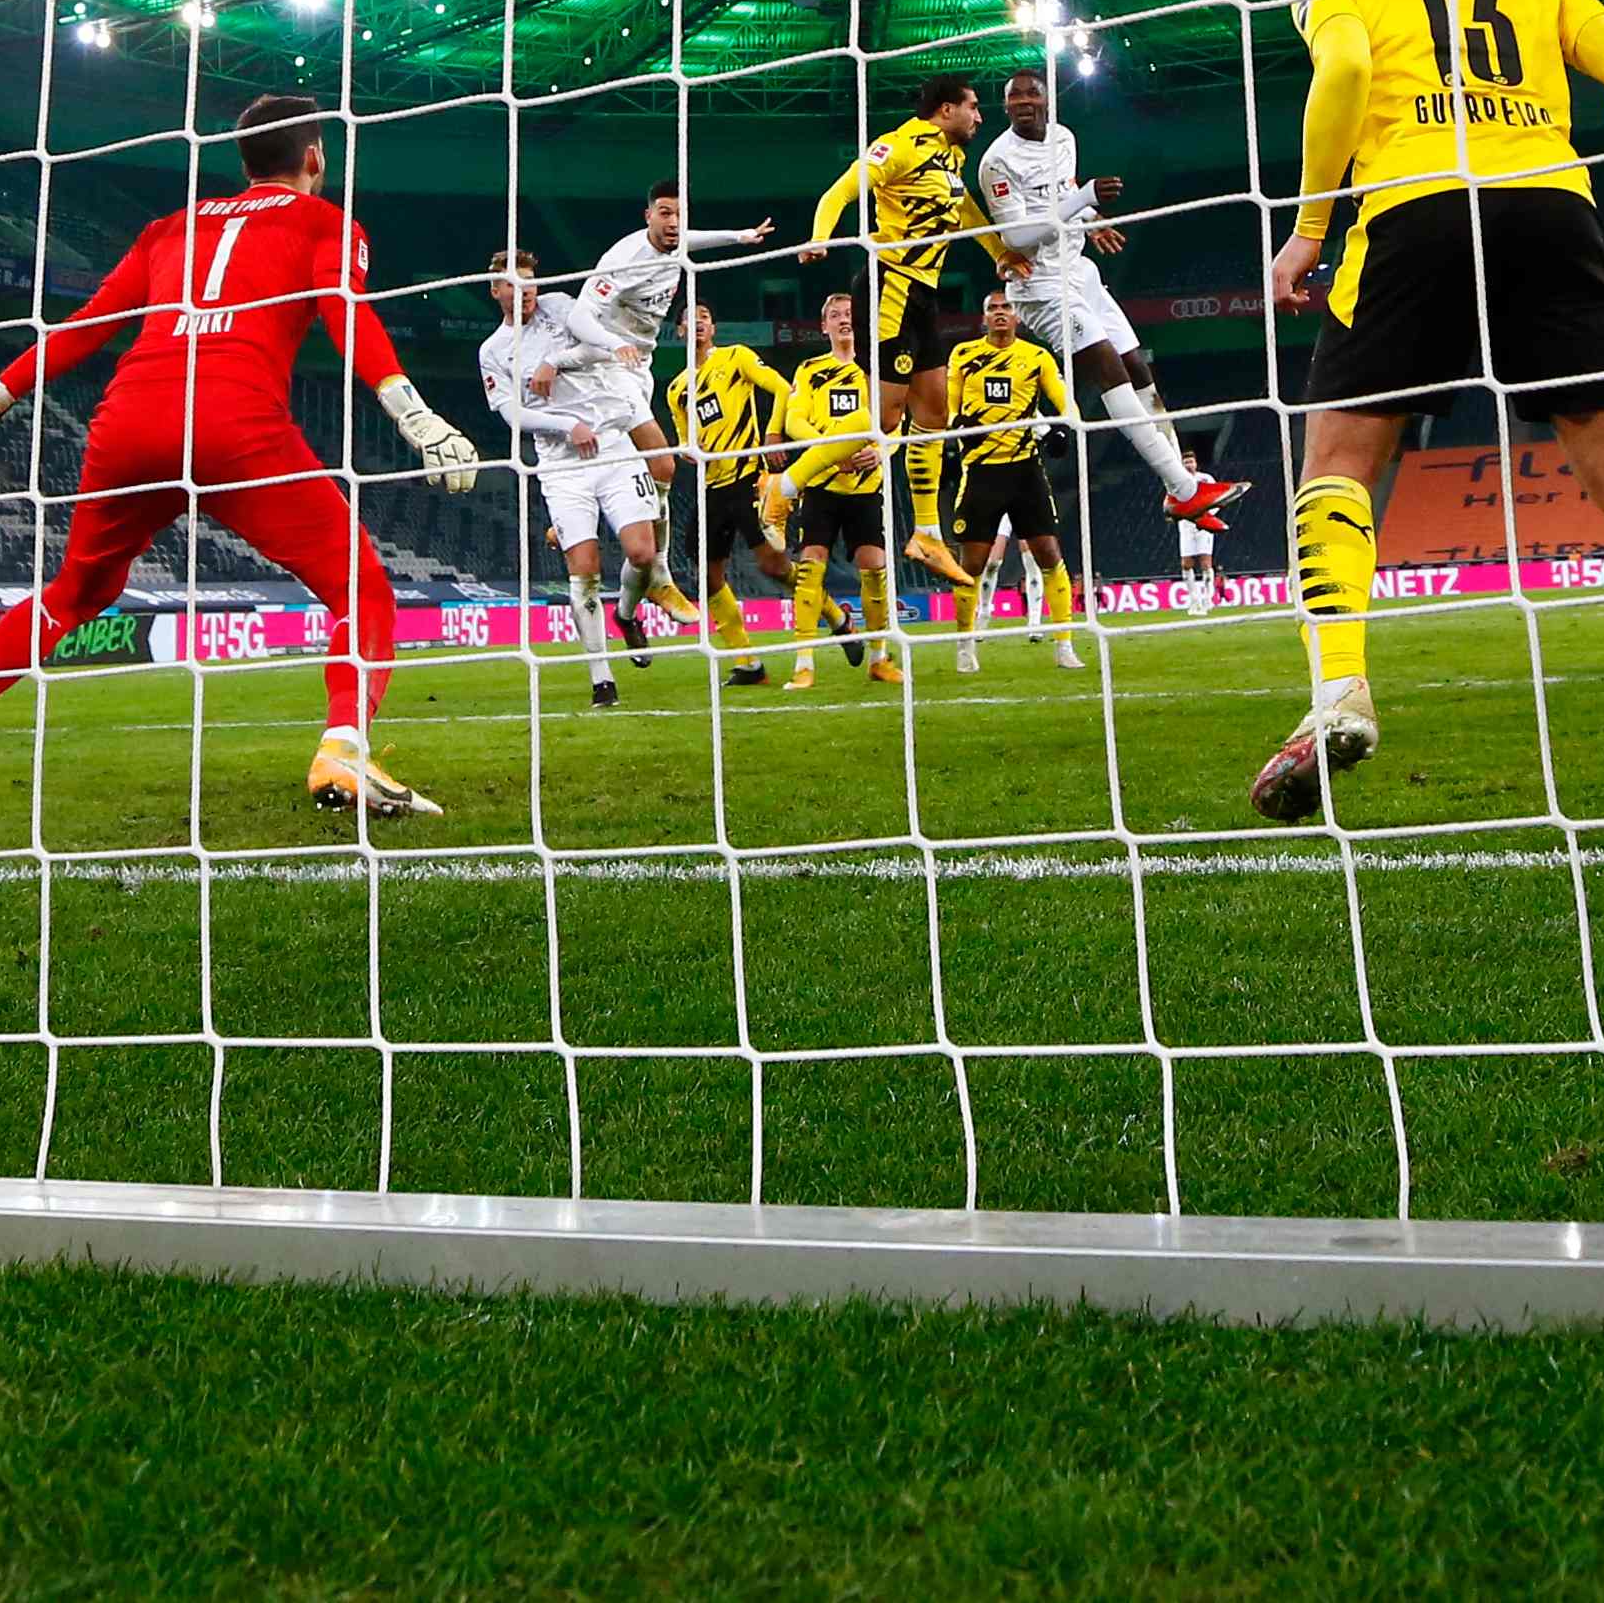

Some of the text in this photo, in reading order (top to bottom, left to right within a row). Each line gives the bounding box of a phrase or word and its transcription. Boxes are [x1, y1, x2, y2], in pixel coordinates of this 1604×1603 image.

[197, 194, 297, 216] DORTMUND
[202, 215, 249, 301] 1
[985, 381, 1010, 398] 1&1
[697, 400, 720, 422] 1&1
[831, 393, 857, 411] 1&1
[631, 471, 655, 498] 30
[1096, 582, 1160, 613] DAS
[1371, 566, 1461, 599] NETZ
